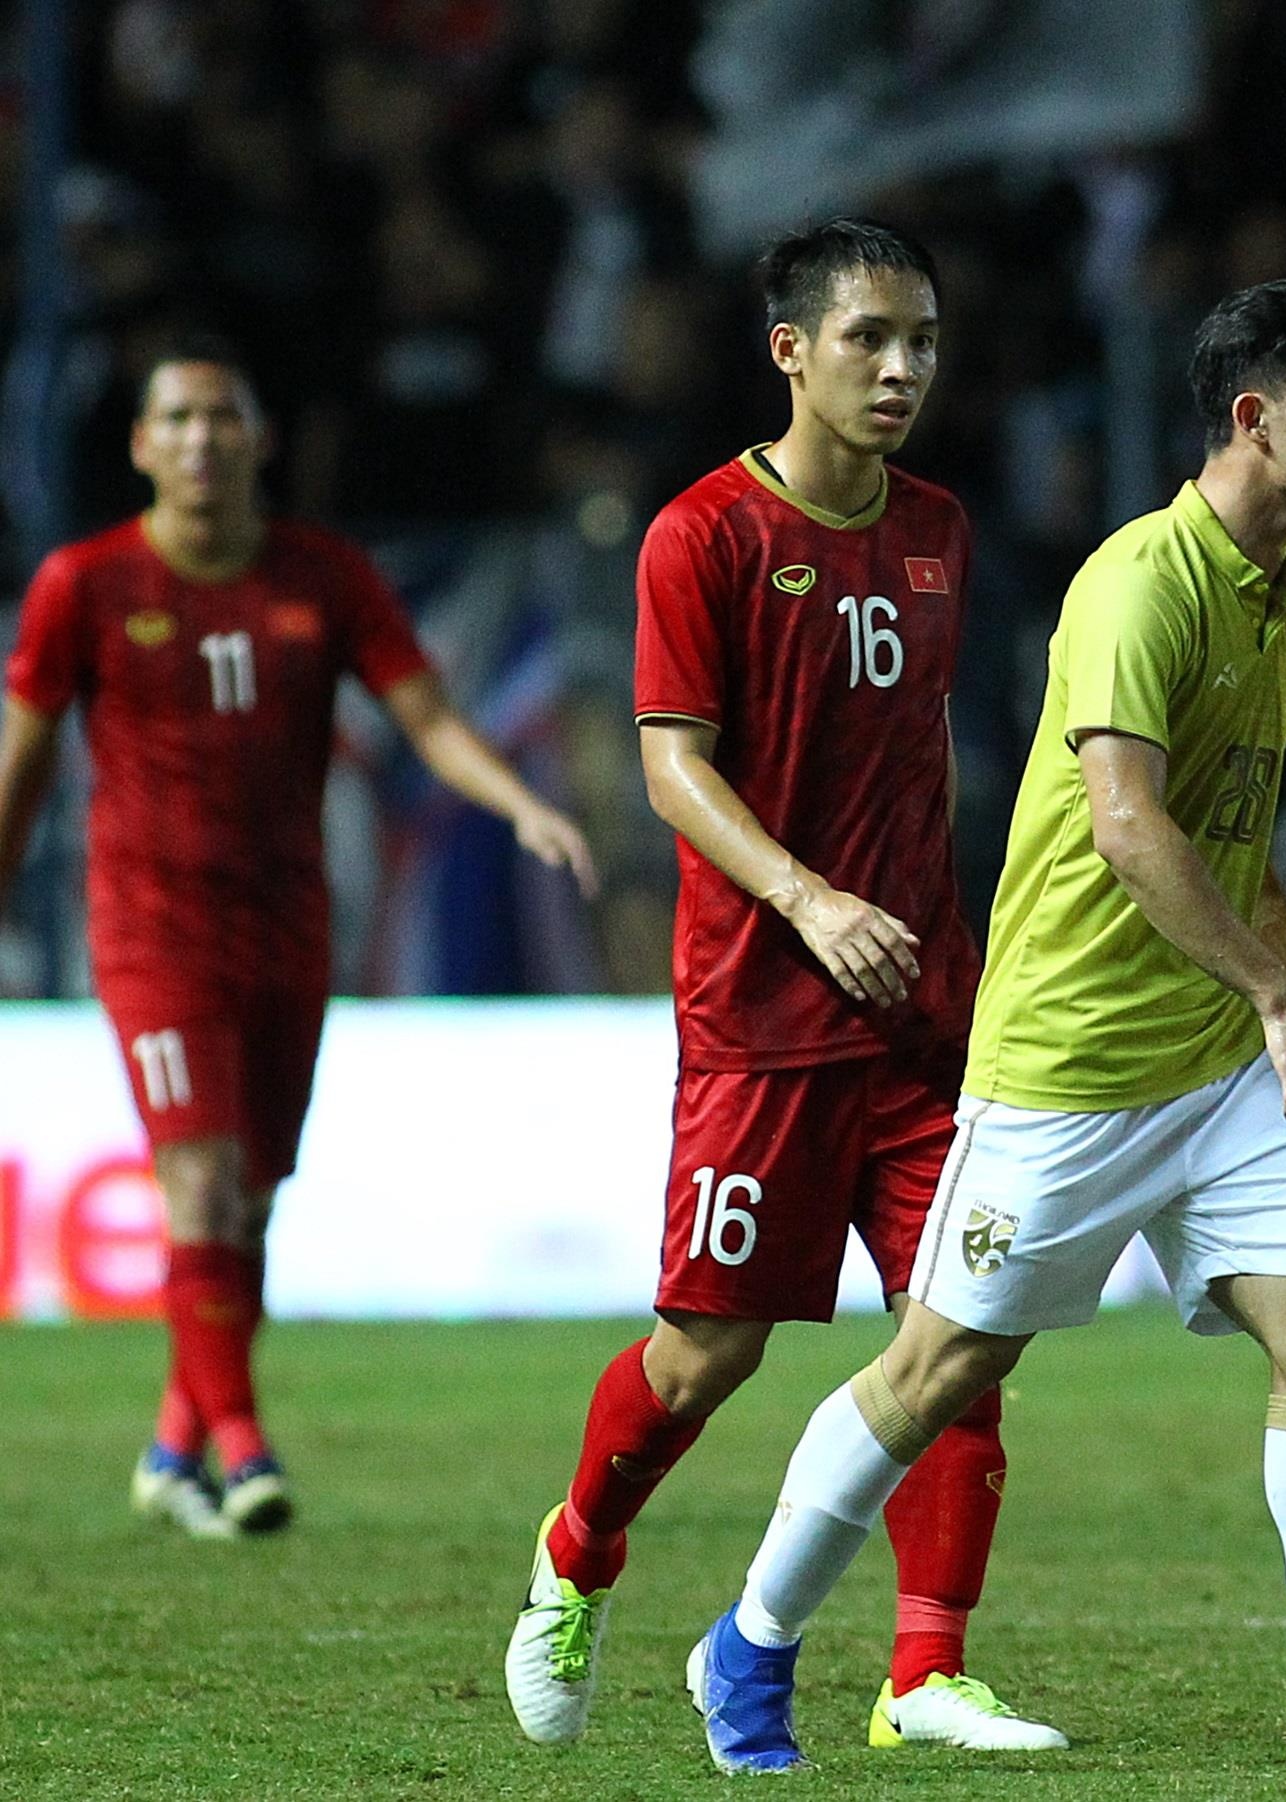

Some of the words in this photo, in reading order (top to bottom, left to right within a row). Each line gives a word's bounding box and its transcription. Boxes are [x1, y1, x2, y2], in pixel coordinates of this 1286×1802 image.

[198, 630, 257, 715] 11
[837, 596, 903, 689] 16
[131, 1028, 193, 1112] 11
[0, 1156, 174, 1322] e
[688, 1166, 763, 1266] 16
